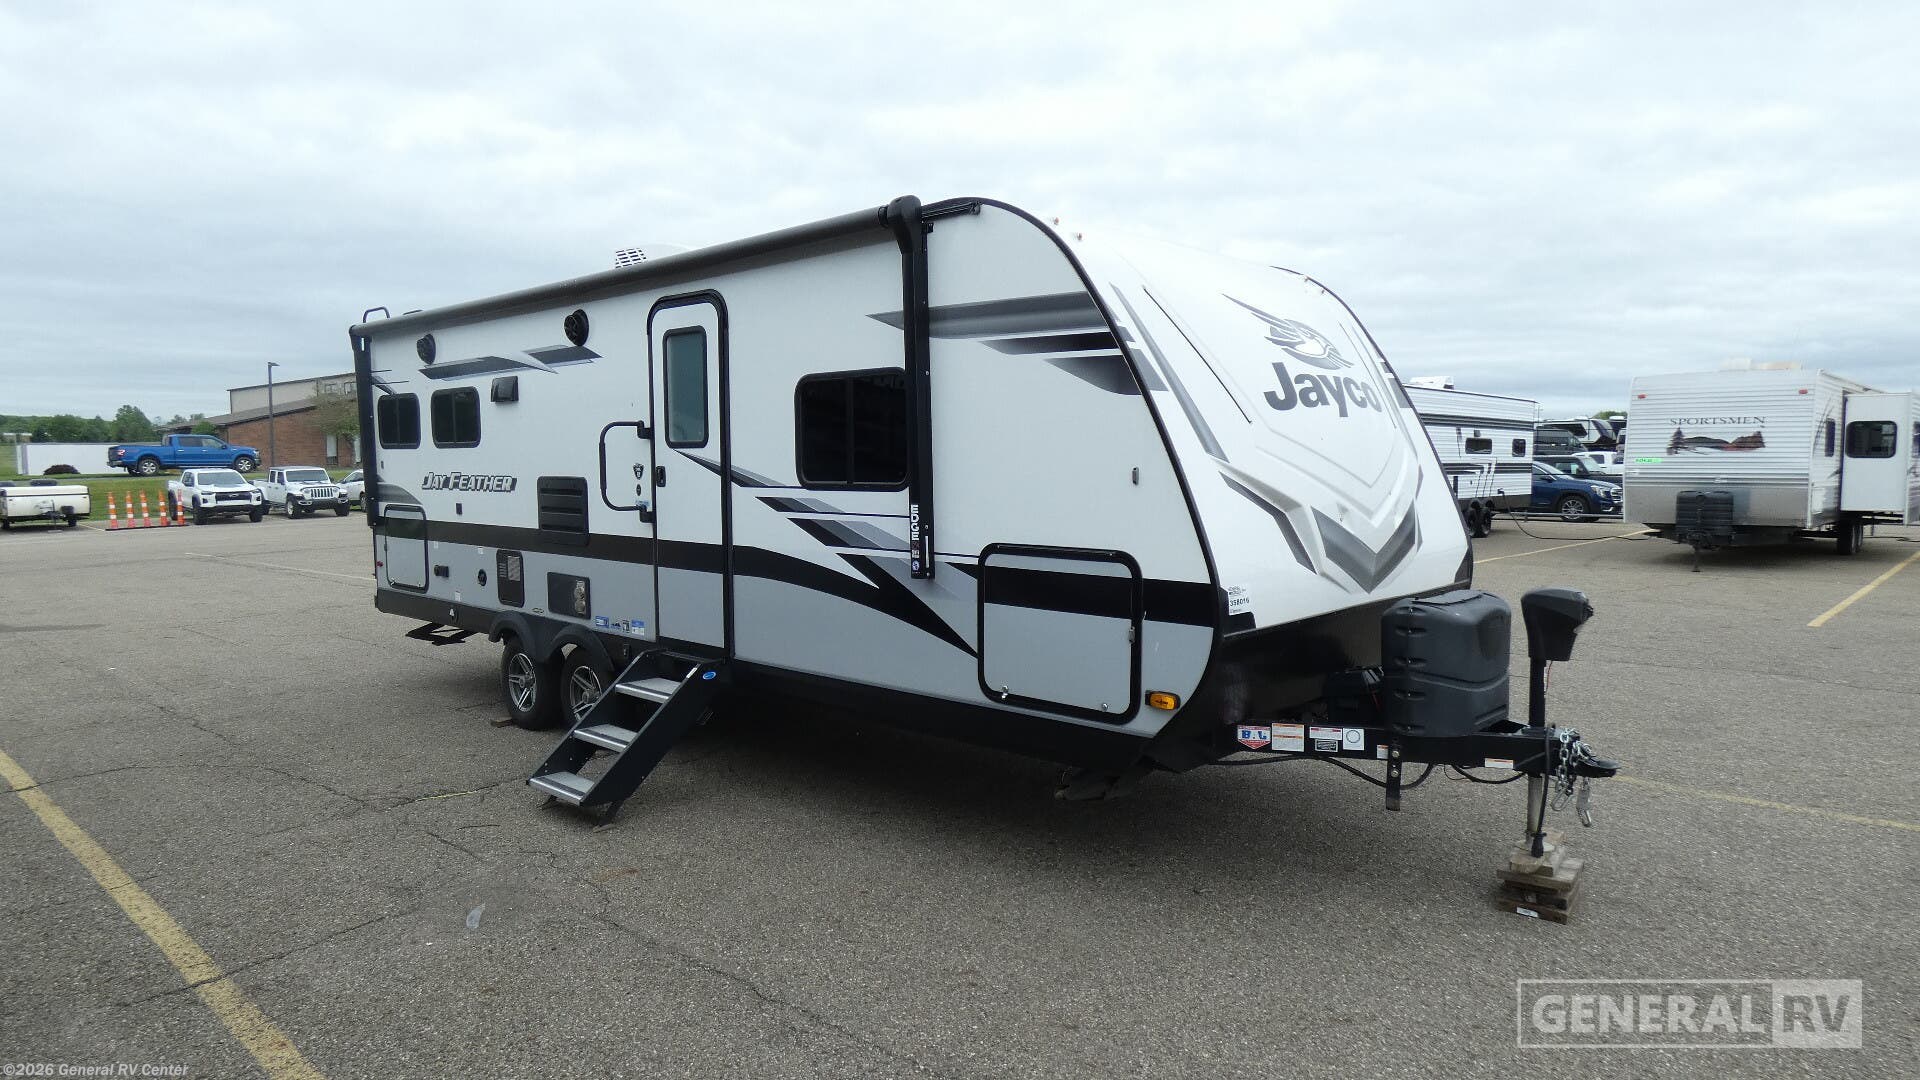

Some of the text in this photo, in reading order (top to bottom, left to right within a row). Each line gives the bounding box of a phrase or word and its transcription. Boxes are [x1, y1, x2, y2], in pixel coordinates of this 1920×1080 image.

[1264, 361, 1382, 417] Jayco
[1669, 416, 1766, 427] SPORTSMEN
[422, 472, 516, 492] JAY FEATHER
[910, 504, 920, 541] EDGE
